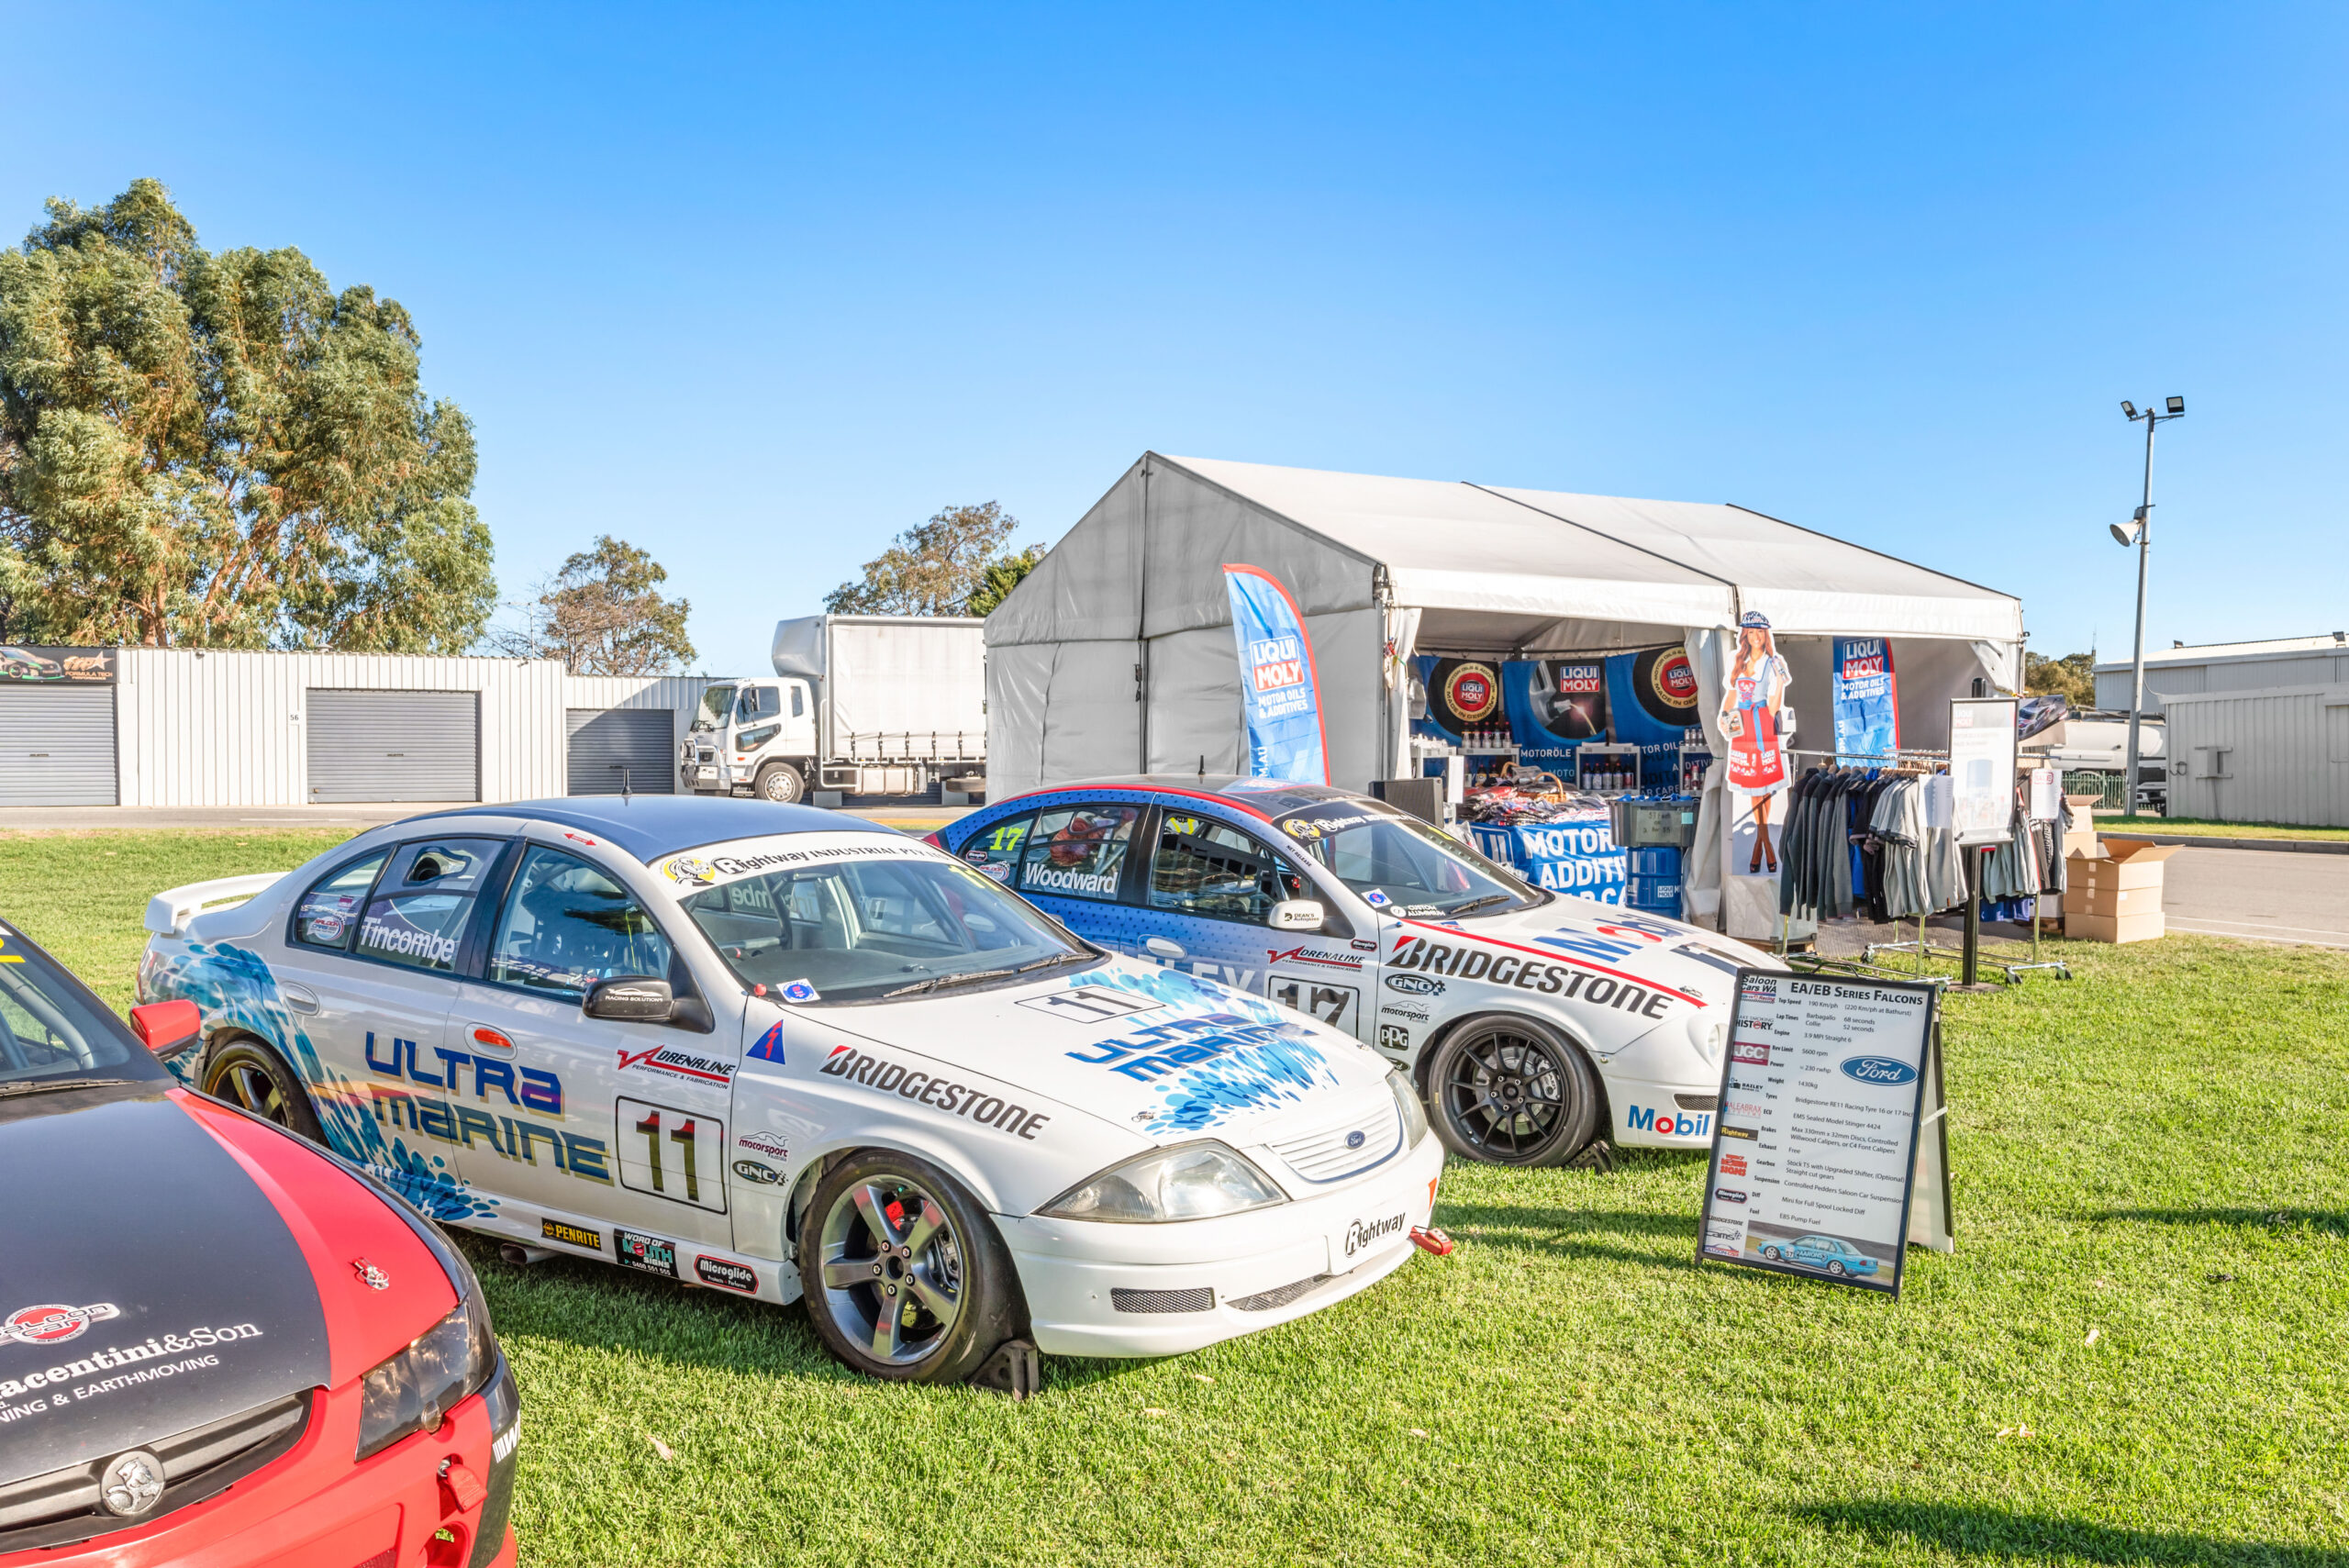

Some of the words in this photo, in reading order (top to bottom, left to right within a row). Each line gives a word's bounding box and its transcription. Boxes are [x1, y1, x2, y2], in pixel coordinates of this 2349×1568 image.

[1253, 639, 1297, 665] LIQUI
[1846, 639, 1880, 660] LIQUI
[1257, 662, 1299, 689] MOLY
[1563, 667, 1597, 679] LIQUI
[1846, 657, 1882, 677] MOLY
[1462, 684, 1483, 693] LIQUI
[1563, 679, 1598, 691] MOLY
[1842, 679, 1868, 691] MOTOR
[1870, 678, 1884, 687] OILS
[1842, 692, 1847, 700] &
[1848, 686, 1884, 700] ADDITIVES
[1258, 694, 1286, 707] MOTOR
[1287, 689, 1305, 700] OILS
[1462, 692, 1483, 700] MOLY
[1259, 708, 1267, 719] &
[1268, 699, 1308, 717] ADDITIVES
[1520, 746, 1571, 758] MOTORÖLE
[990, 827, 1024, 851] 17
[1523, 828, 1616, 859] MOTOR
[810, 847, 896, 858] INDUSTRIAL
[1295, 850, 1312, 867] RELEASE
[1026, 862, 1118, 894] Woodward
[361, 916, 454, 962] Tincombe
[1533, 913, 1700, 963] Mobil
[1280, 945, 1365, 964] ADRENALINE
[1385, 935, 1675, 1020] BRIDGESTONE
[1763, 984, 1776, 994] WA
[1791, 982, 1831, 996] EA/EB
[1047, 991, 1143, 1017] 11
[1381, 1006, 1430, 1021] motorsport
[1820, 1001, 1838, 1009] Km/ph
[1858, 1006, 1877, 1014] Km/ph
[1886, 1007, 1911, 1017] Bathurst)
[1852, 1018, 1876, 1026] seconds
[1381, 1027, 1408, 1047] PPG
[1825, 1035, 1846, 1043] Straight
[629, 1044, 735, 1077] ADRENALINE
[1734, 1045, 1765, 1060] JGC
[632, 1063, 678, 1078] PERFORMANCE
[686, 1077, 728, 1090] FABRICATION
[1855, 1059, 1902, 1081] Ford
[818, 1044, 1051, 1140] BRIDGESTONE
[1798, 1081, 1818, 1090] 1430kg
[1628, 1105, 1709, 1136] Mobil
[1807, 1114, 1824, 1123] Sealed
[1826, 1117, 1843, 1126] Model
[1845, 1120, 1865, 1129] Stinger
[1721, 1127, 1749, 1139] Rightway
[1805, 1128, 1825, 1137] 330mm
[1831, 1131, 1849, 1140] 32mm
[1868, 1137, 1898, 1147] Controlled
[636, 1110, 699, 1202] 11
[739, 1139, 788, 1159] motorsport
[1873, 1145, 1896, 1155] Calipers
[738, 1162, 776, 1183] GNC
[1756, 1159, 1775, 1167] Gearbox
[1787, 1159, 1801, 1167] Stock
[1825, 1165, 1853, 1175] Upgraded
[1876, 1173, 1905, 1184] (Optional)
[1787, 1167, 1808, 1176] Straight
[1754, 1175, 1780, 1184] Suspension
[1784, 1180, 1813, 1190] Controlled
[1814, 1184, 1837, 1194] Pedders
[1839, 1188, 1858, 1197] Saloon
[1816, 1201, 1831, 1210] Spool
[1833, 1204, 1854, 1214] Locked
[1791, 1215, 1807, 1223] Pump
[556, 1224, 600, 1249] PENRITE
[625, 1231, 651, 1245] WORD
[651, 1239, 664, 1248] OF
[1345, 1212, 1406, 1257] Rightway
[643, 1257, 671, 1269] SIGNS
[700, 1260, 751, 1283] Microglide
[52, 1393, 71, 1407] &
[73, 1353, 219, 1400] EARTHMOVING
